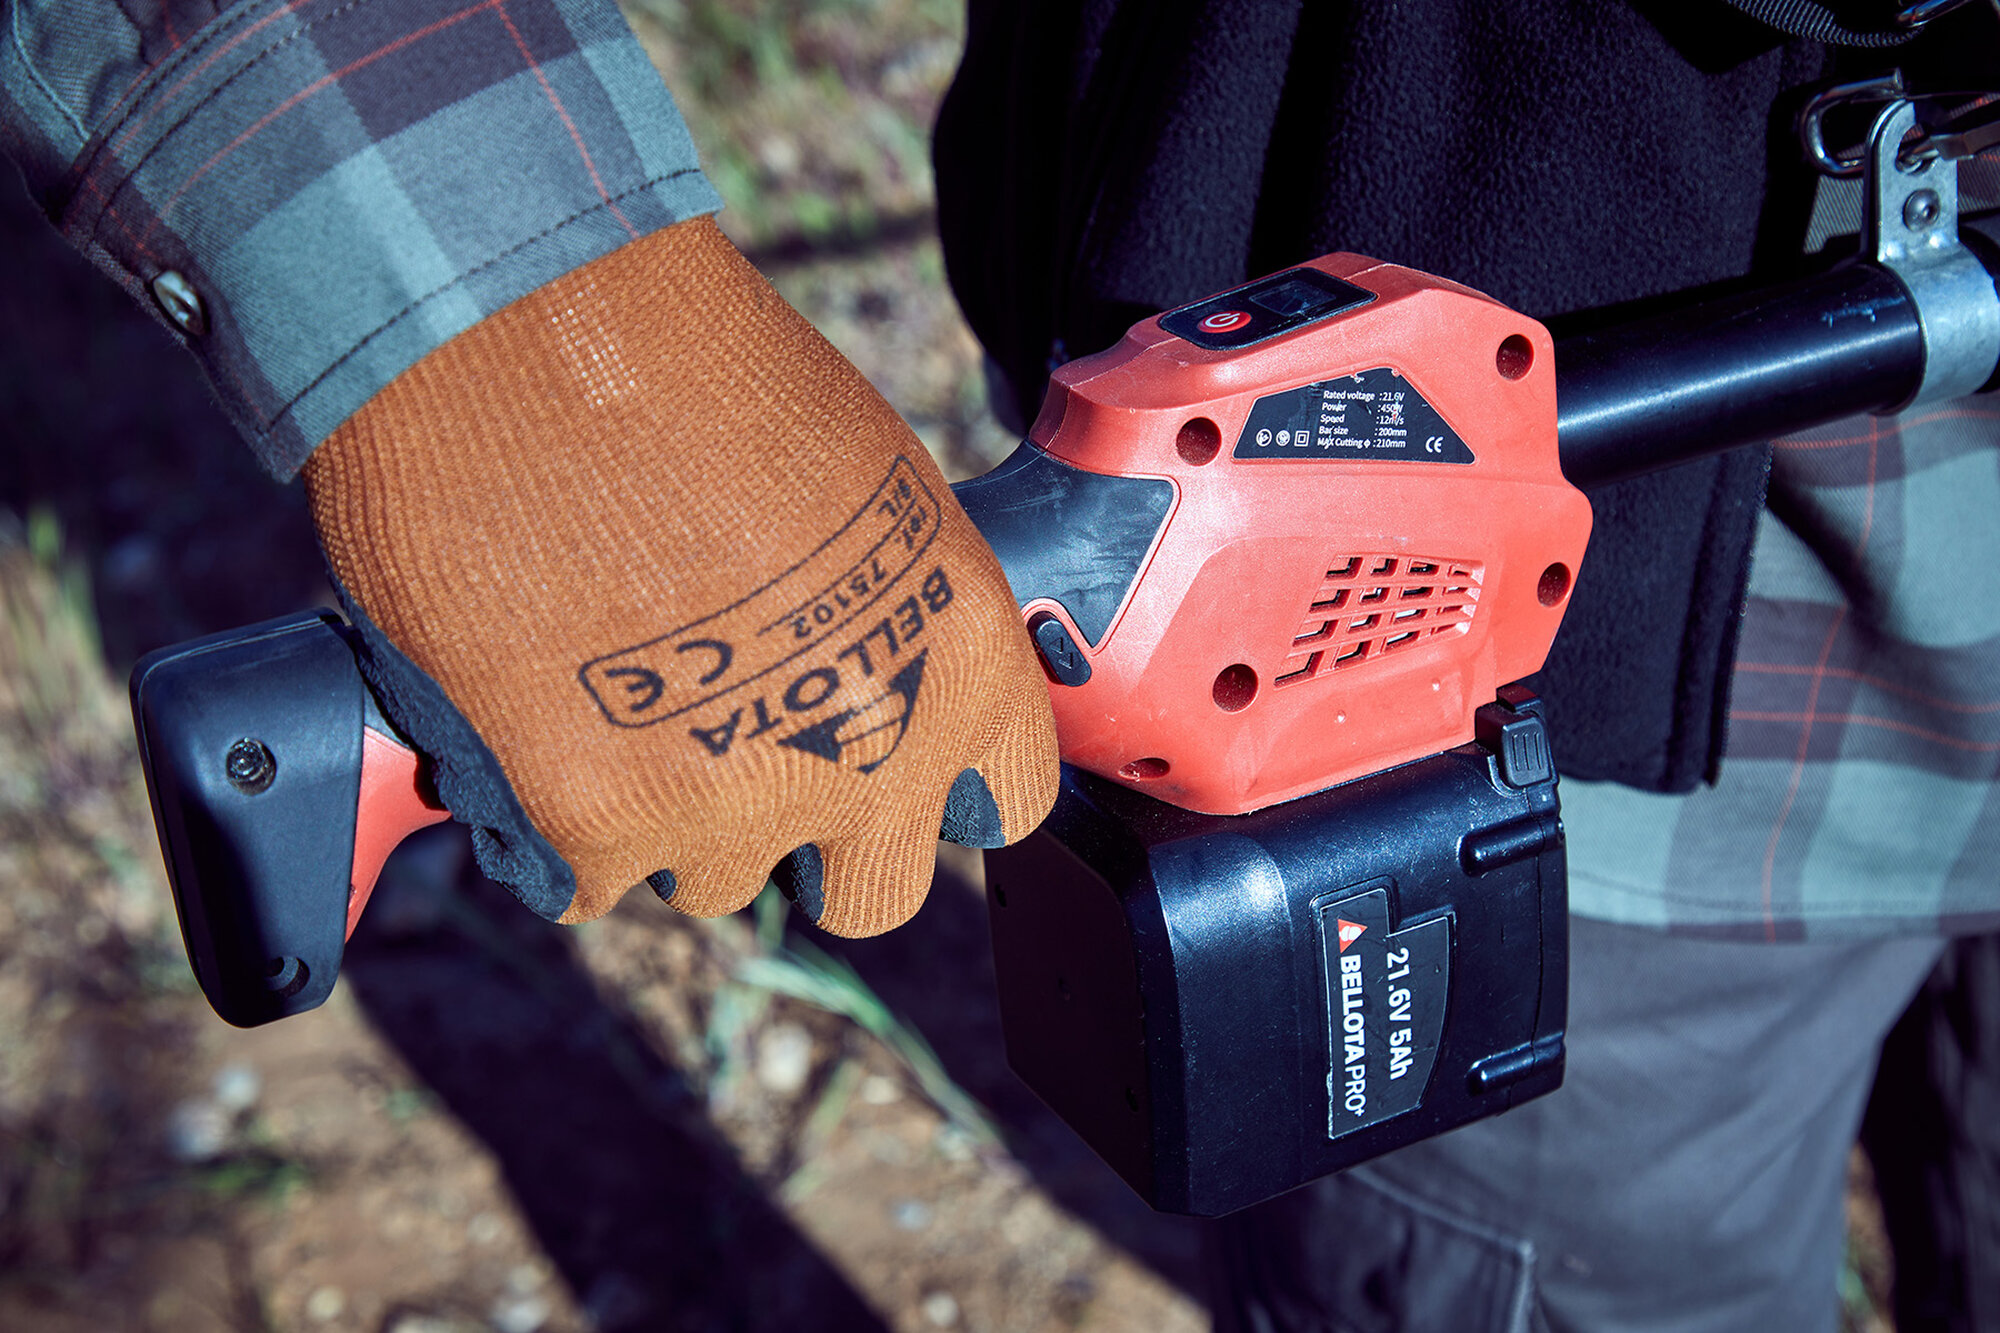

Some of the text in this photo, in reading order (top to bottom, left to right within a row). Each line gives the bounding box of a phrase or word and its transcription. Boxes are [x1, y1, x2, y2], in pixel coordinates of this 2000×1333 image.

[1323, 390, 1346, 400] Rated
[1347, 391, 1375, 402] voltage
[1321, 402, 1347, 412] Power
[1320, 413, 1345, 424] Speed
[1318, 426, 1332, 435] Bar
[1333, 426, 1349, 435] size
[1317, 438, 1334, 447] MAX
[1335, 438, 1363, 449] Cutting
[1425, 436, 1444, 453] CE
[788, 558, 889, 639] 75102
[689, 565, 954, 757] BELLOTA
[605, 638, 733, 712] CE
[1387, 947, 1413, 1081] 21.6V 5Ah
